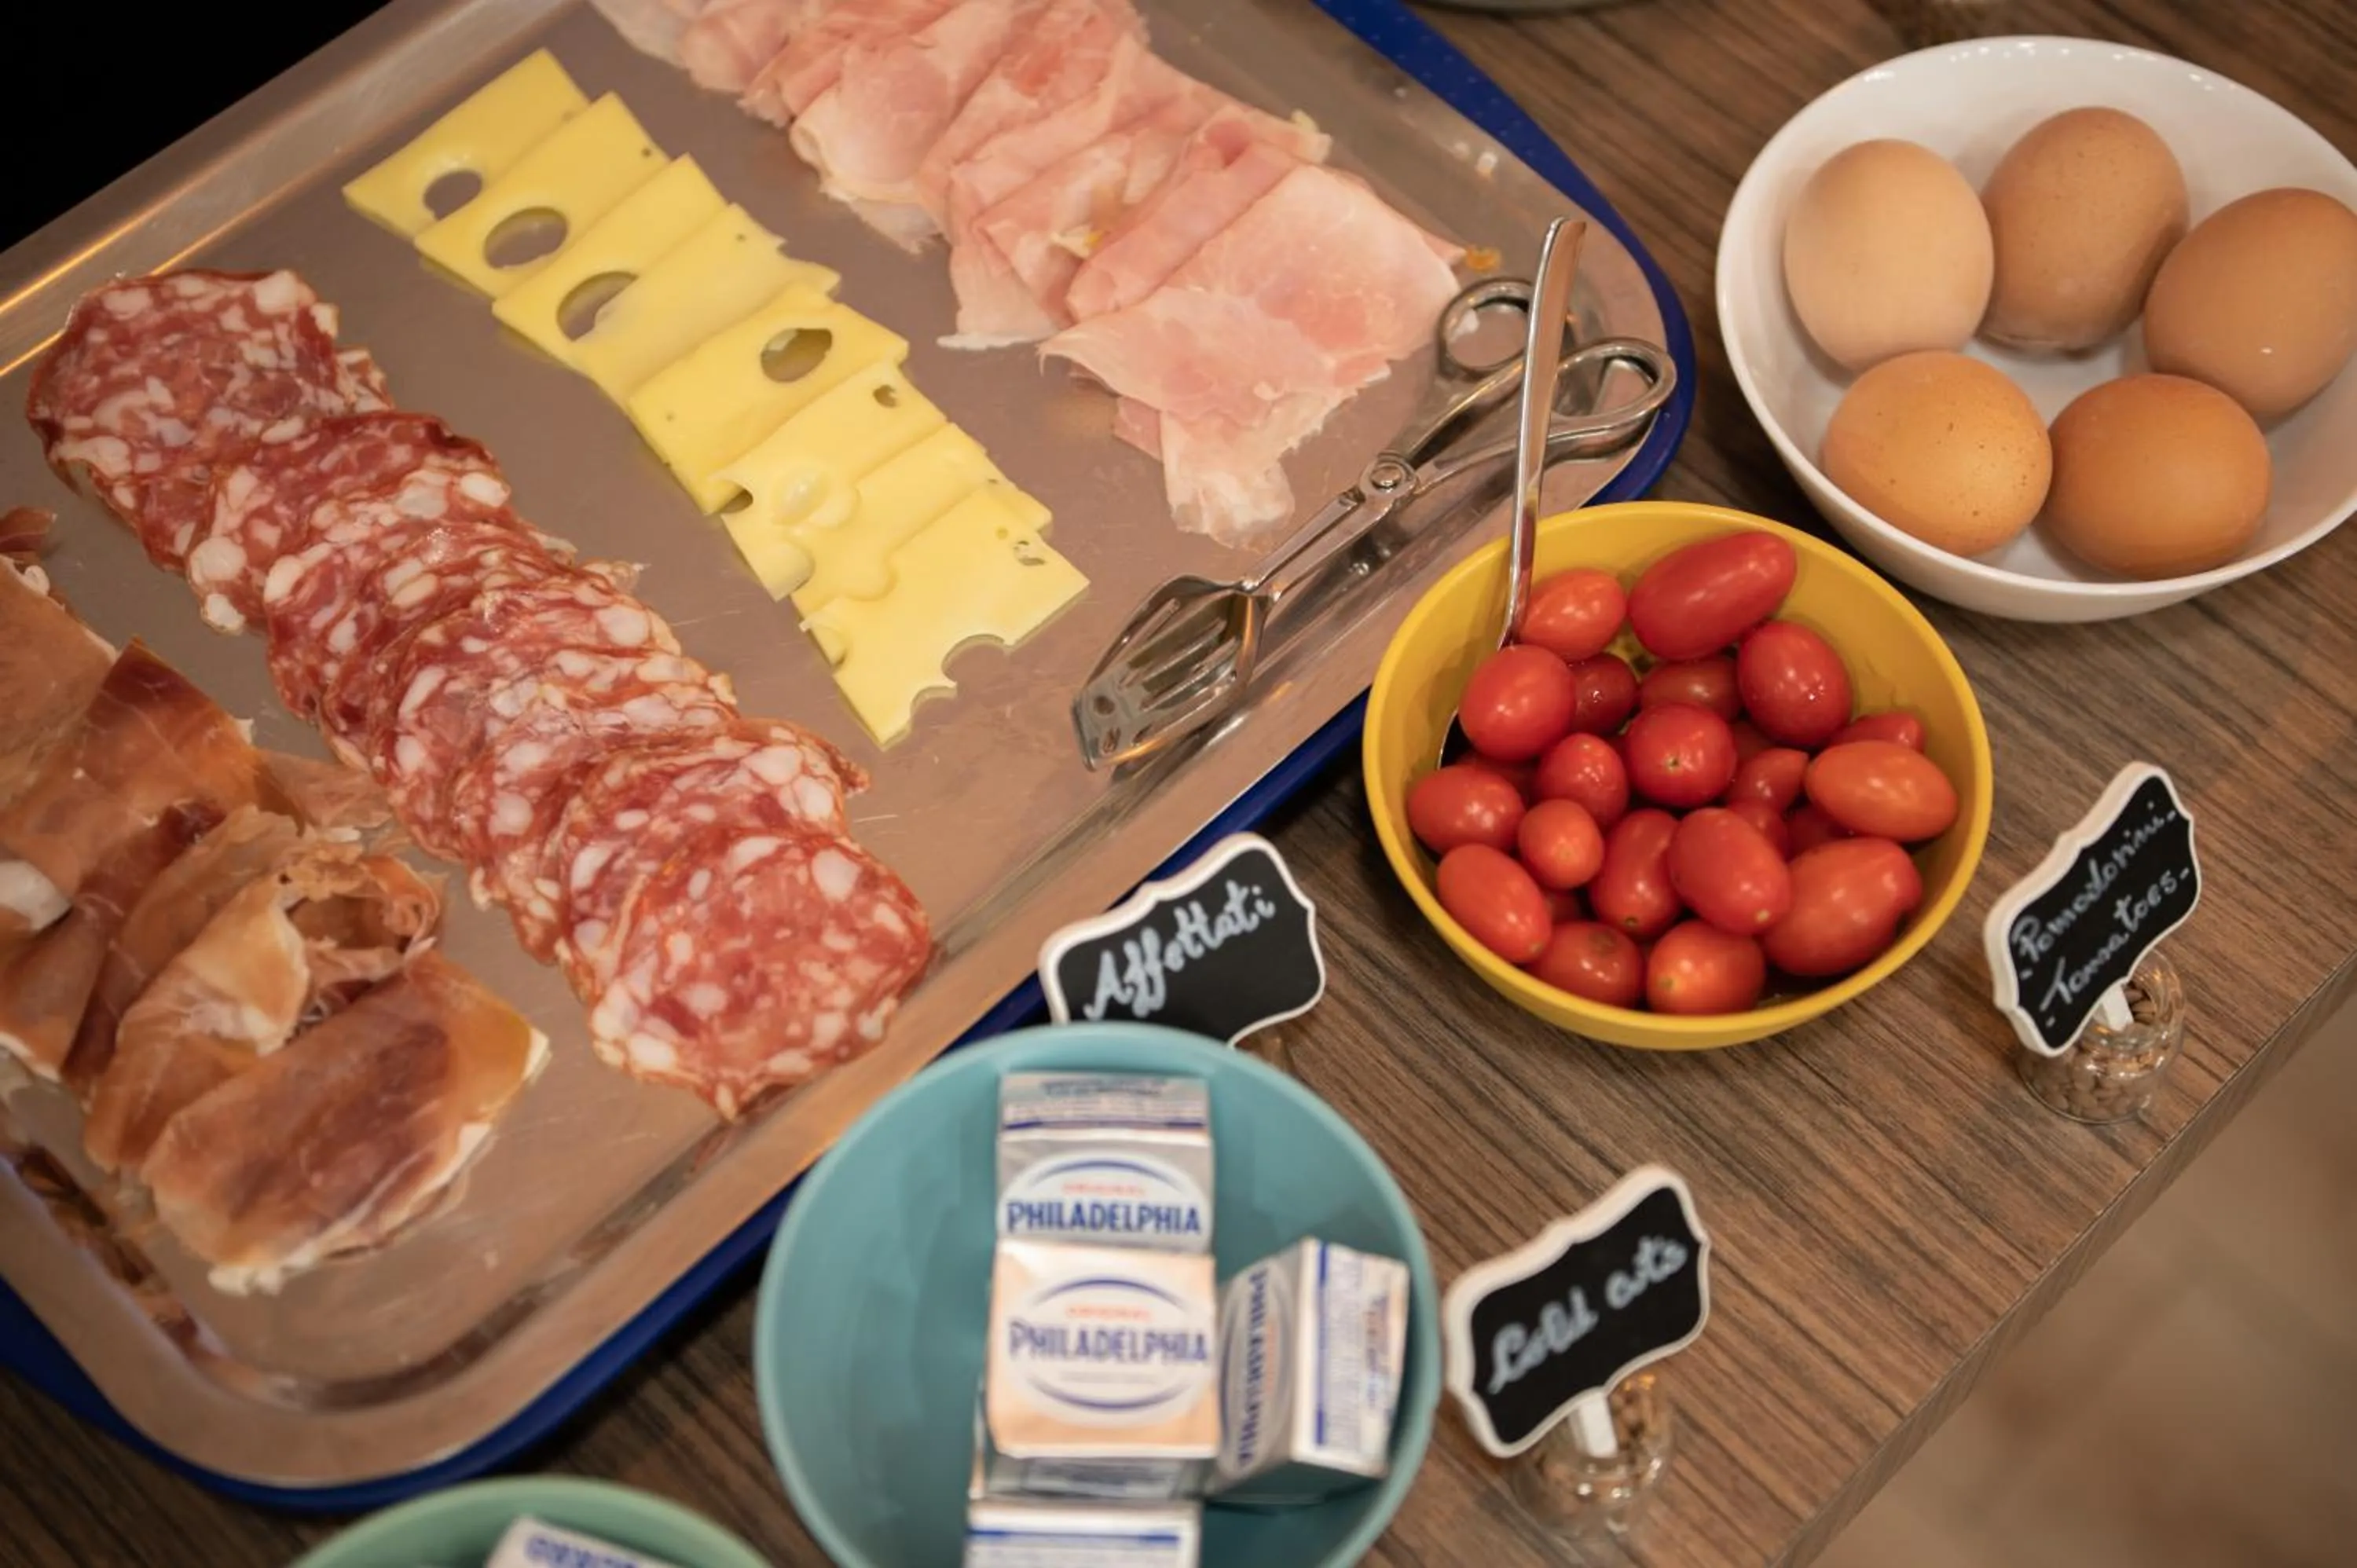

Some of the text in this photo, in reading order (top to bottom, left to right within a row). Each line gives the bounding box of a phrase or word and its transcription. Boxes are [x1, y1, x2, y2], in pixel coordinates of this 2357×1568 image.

[1083, 879, 1276, 1019] Affottati
[1006, 1200, 1202, 1235] PHILADELPHIA
[1009, 1318, 1209, 1364] PHILADELPHIA
